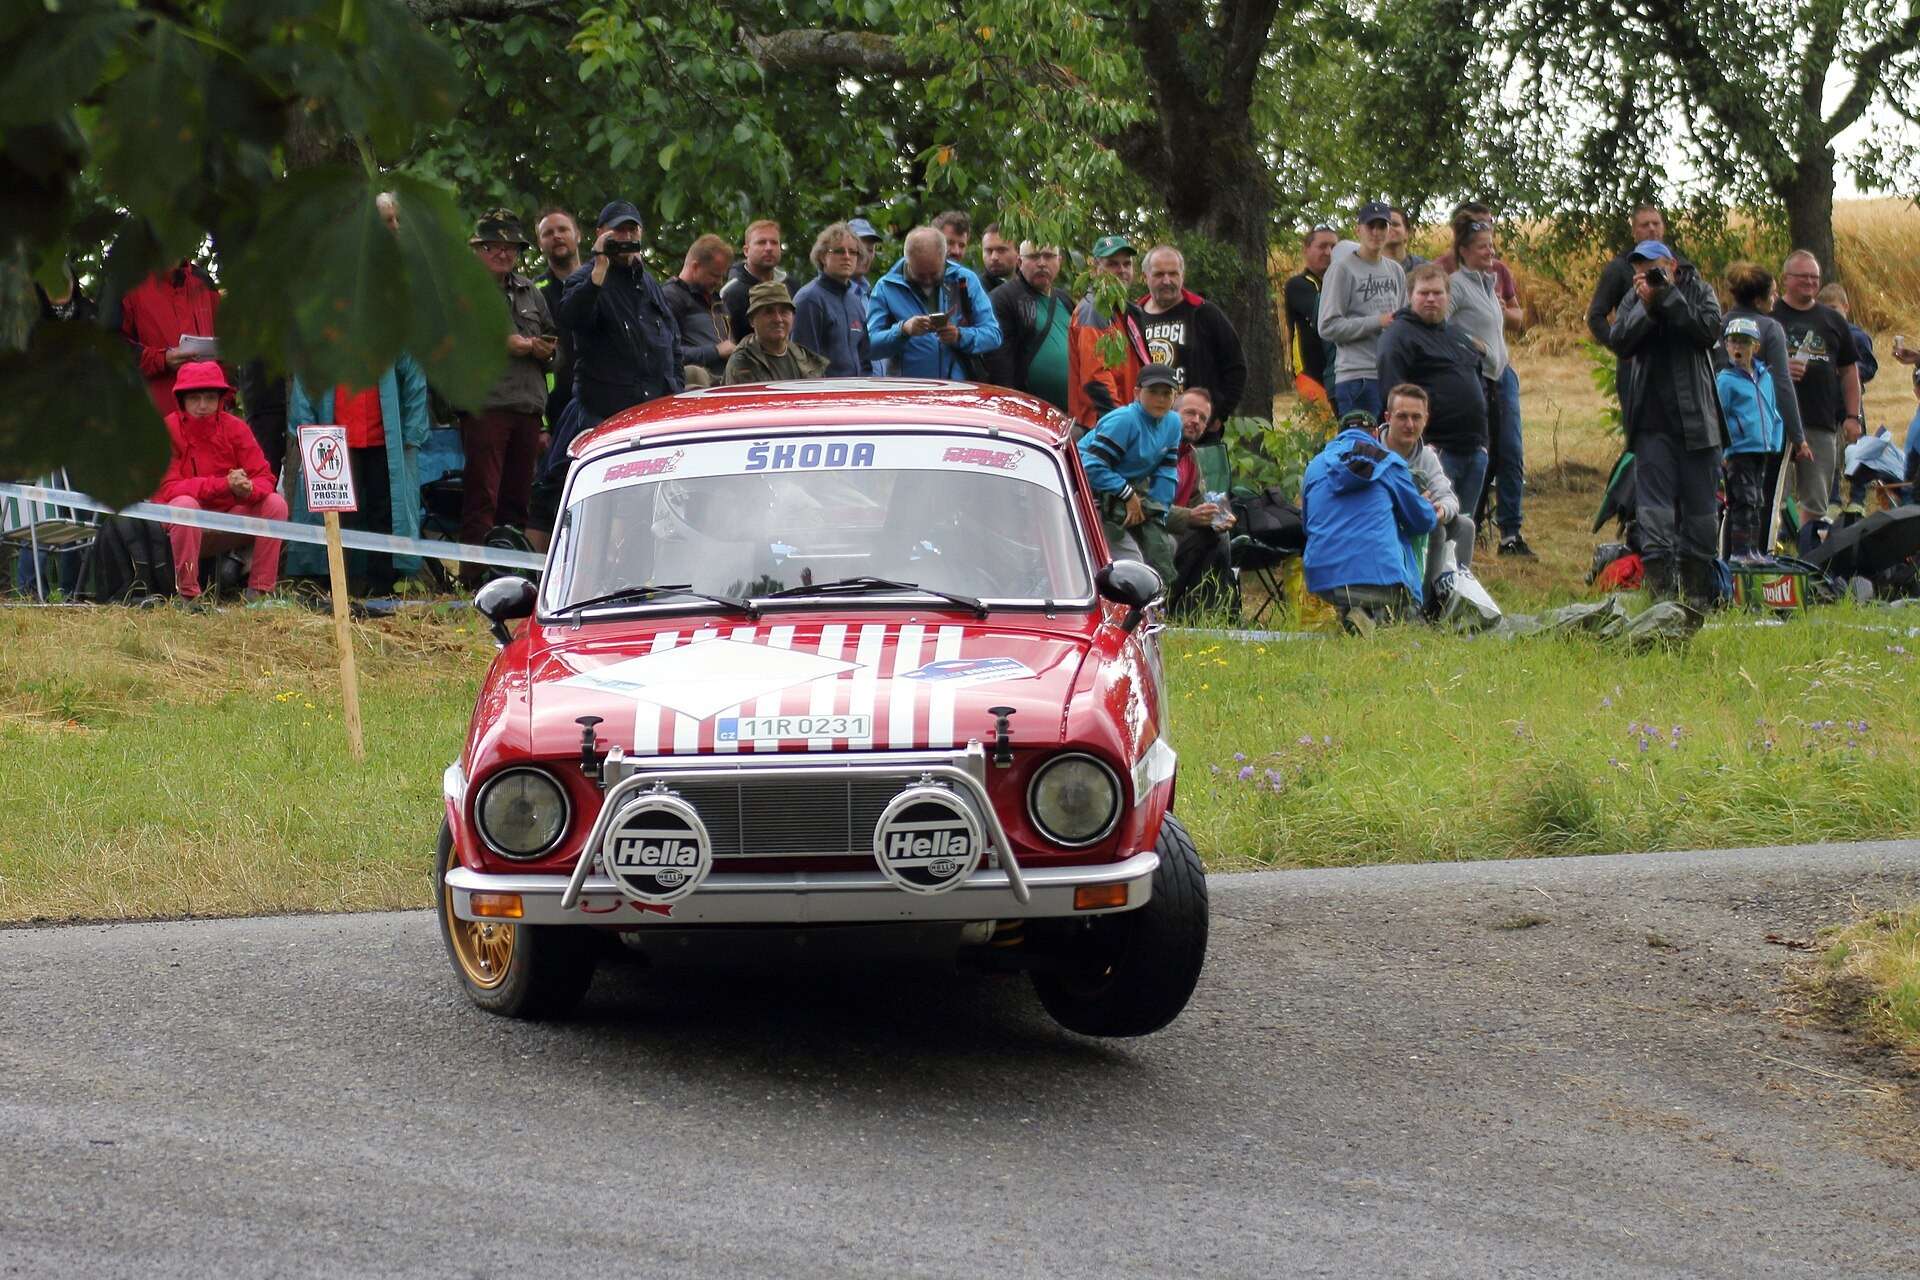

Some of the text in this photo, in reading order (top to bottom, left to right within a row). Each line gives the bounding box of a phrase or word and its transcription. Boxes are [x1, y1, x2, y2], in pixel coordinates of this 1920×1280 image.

[745, 441, 875, 471] ŠKODA
[314, 491, 349, 499] PROSOR
[745, 718, 863, 736] 11R 0231
[617, 840, 697, 865] Hella
[888, 831, 968, 858] Hella
